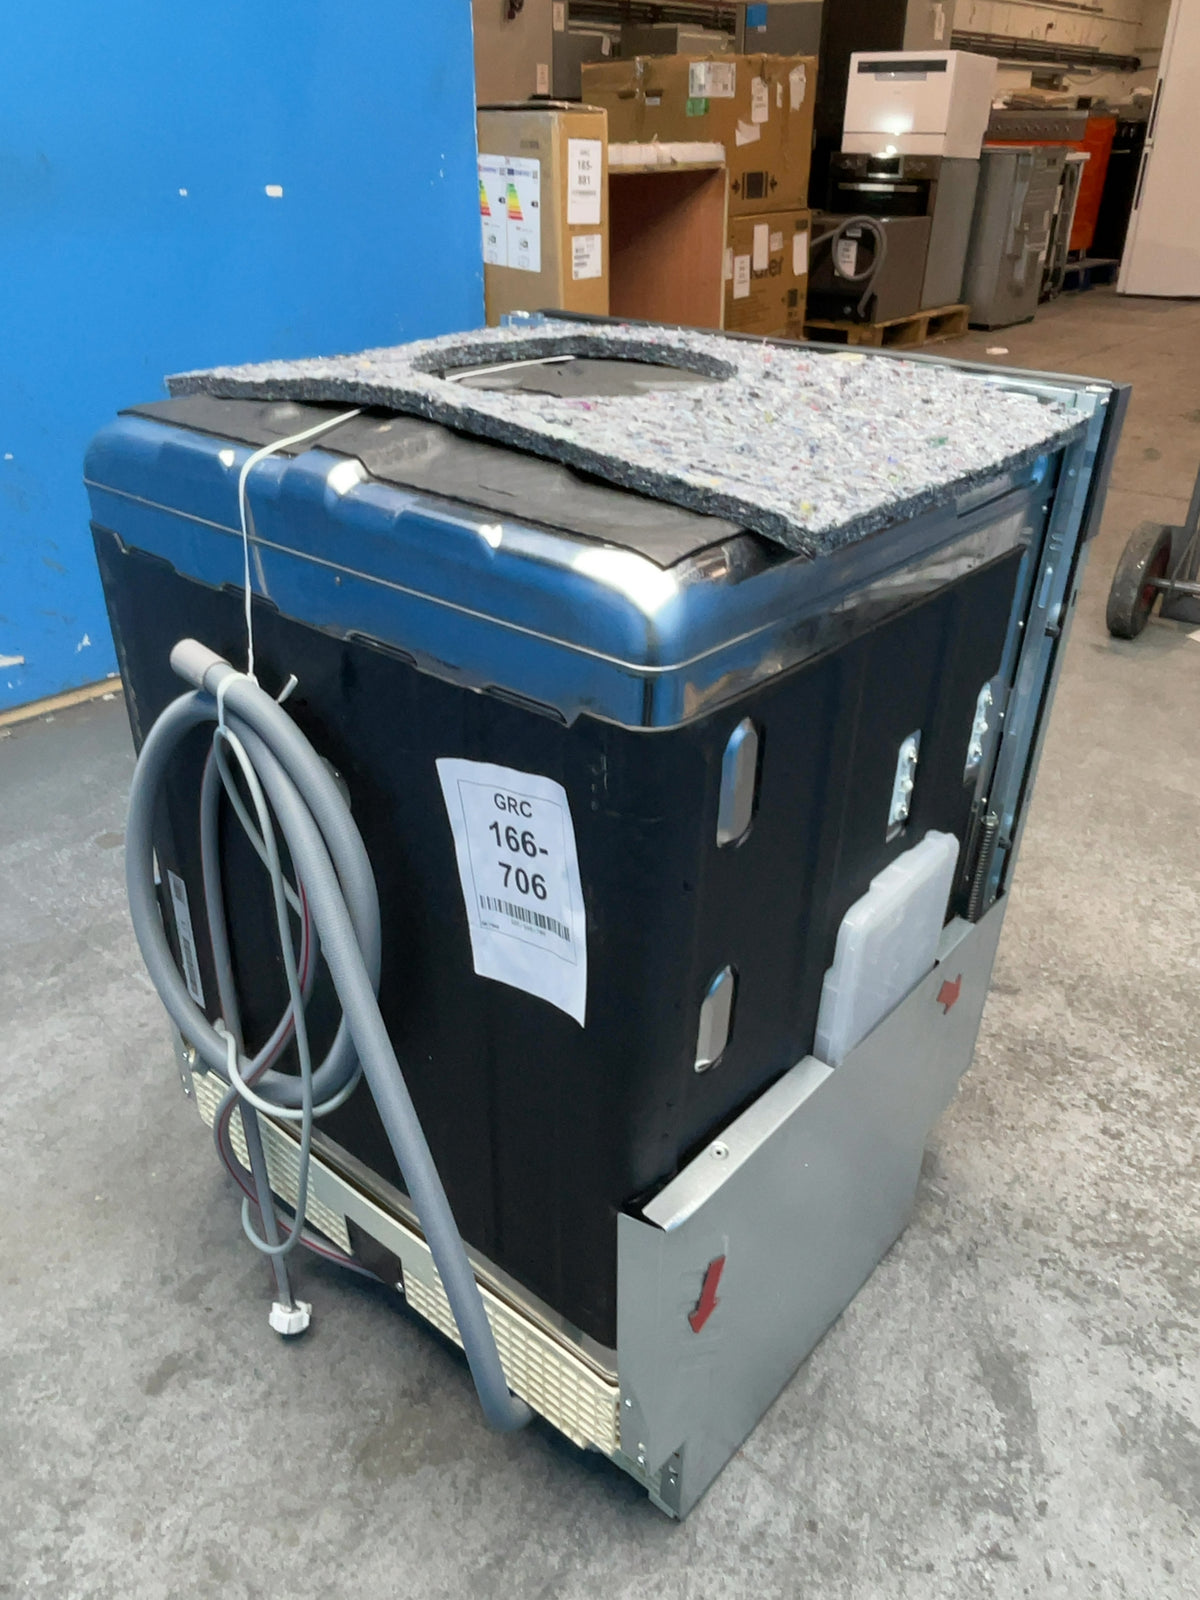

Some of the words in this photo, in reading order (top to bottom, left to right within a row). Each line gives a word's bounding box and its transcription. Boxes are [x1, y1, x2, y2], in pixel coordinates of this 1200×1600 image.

[494, 793, 533, 818] GRC
[489, 820, 548, 858] 166-
[498, 861, 547, 900] 706
